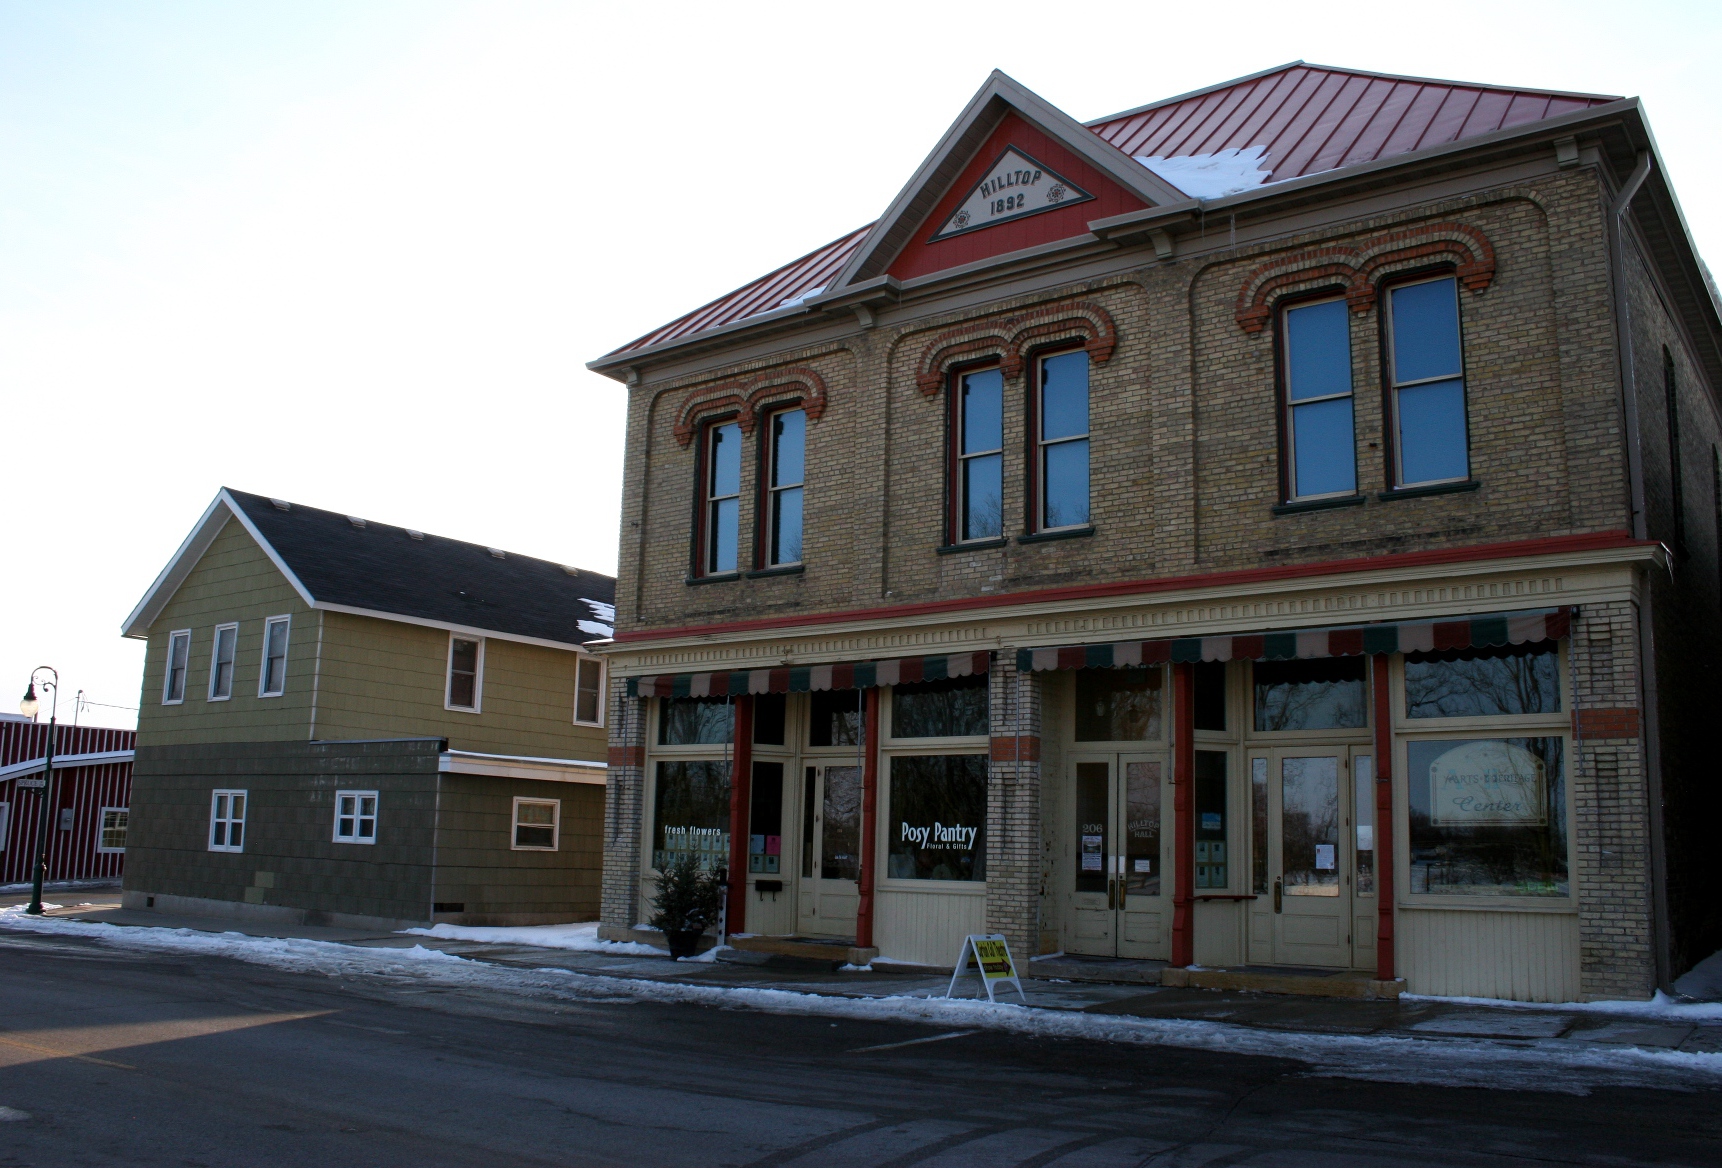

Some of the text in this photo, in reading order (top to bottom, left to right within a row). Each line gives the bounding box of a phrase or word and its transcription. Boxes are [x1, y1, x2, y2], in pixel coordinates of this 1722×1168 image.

[980, 170, 1042, 199] HILLTOP
[991, 193, 1025, 216] 1892
[1453, 796, 1523, 812] Center
[664, 825, 721, 836] fresh flowers
[1082, 823, 1103, 834] 206
[1128, 820, 1159, 832] HILLTOP
[901, 821, 977, 850] Posy Pantry
[1134, 830, 1154, 838] HALL
